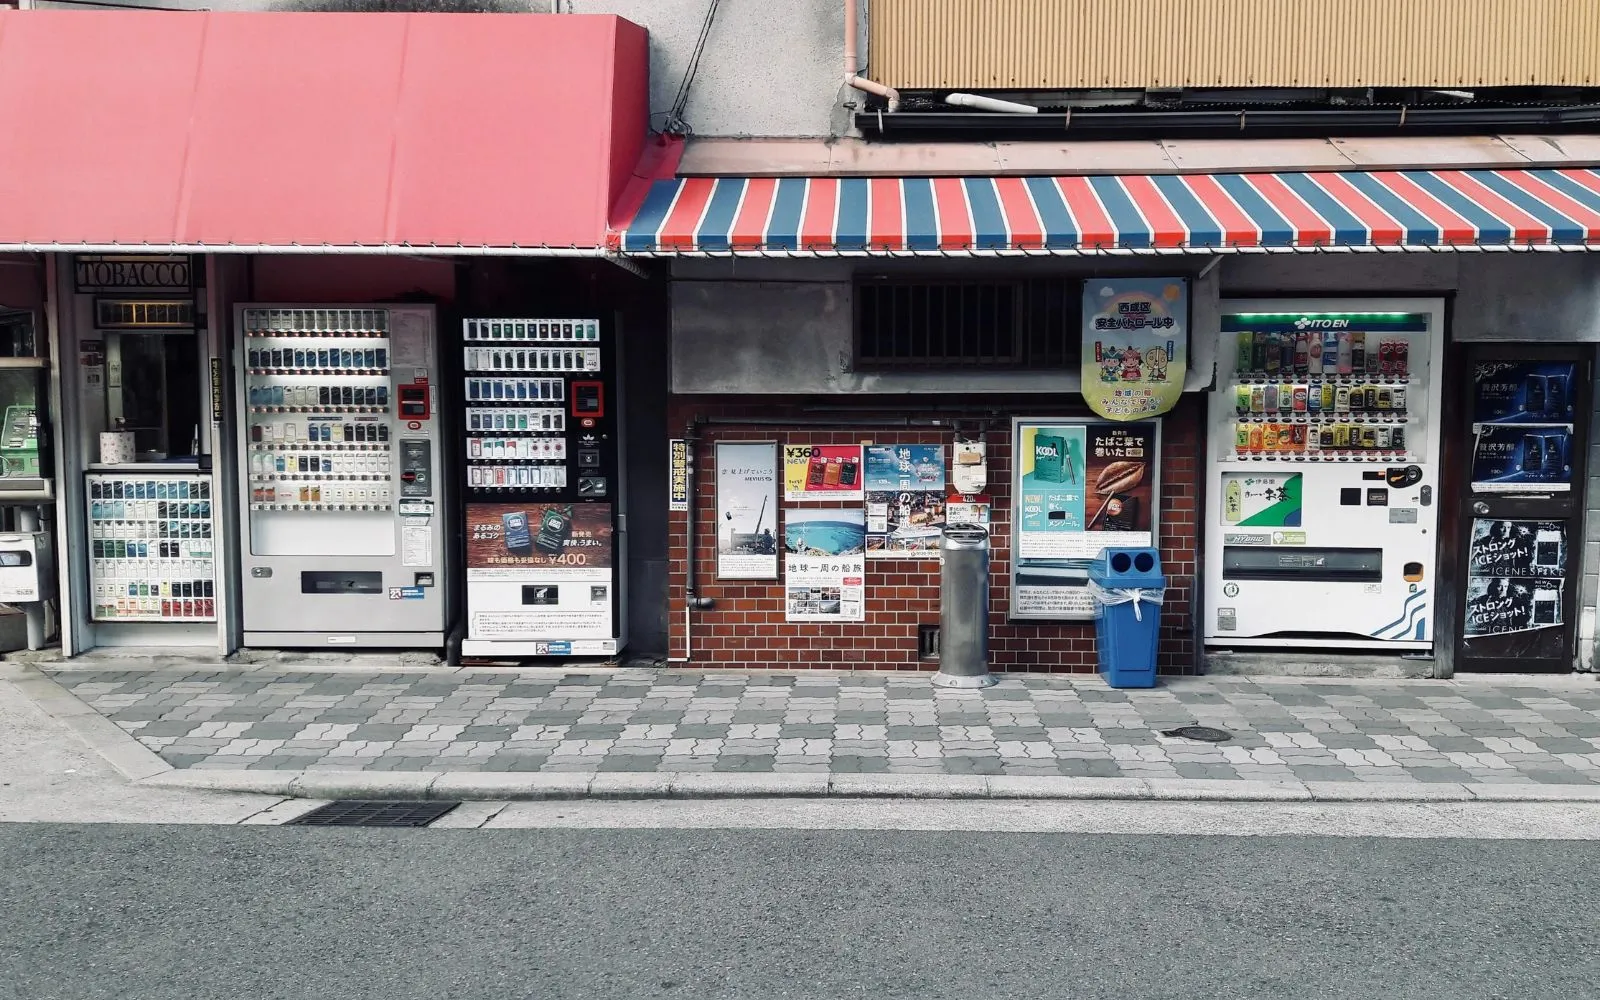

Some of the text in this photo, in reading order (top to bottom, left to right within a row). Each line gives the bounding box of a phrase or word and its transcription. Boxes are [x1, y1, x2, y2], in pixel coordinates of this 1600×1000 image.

[77, 262, 187, 286] TOBACCO
[1095, 318, 1174, 330] 安全パトロール中
[1310, 319, 1350, 328] ITO EN
[1095, 436, 1144, 447] たばこ葉で
[786, 447, 821, 458] ¥360
[1035, 446, 1059, 457] KOOL
[672, 442, 686, 501] 特別警戒実施中
[899, 448, 911, 528] 地球一周の船旅
[1233, 535, 1264, 543] HYBRID
[1471, 538, 1517, 559] ストロング
[549, 553, 586, 565] ¥400
[788, 563, 862, 573] 地球一周の船旅
[1491, 567, 1527, 576] ICENE
[1467, 597, 1514, 618] ストロング
